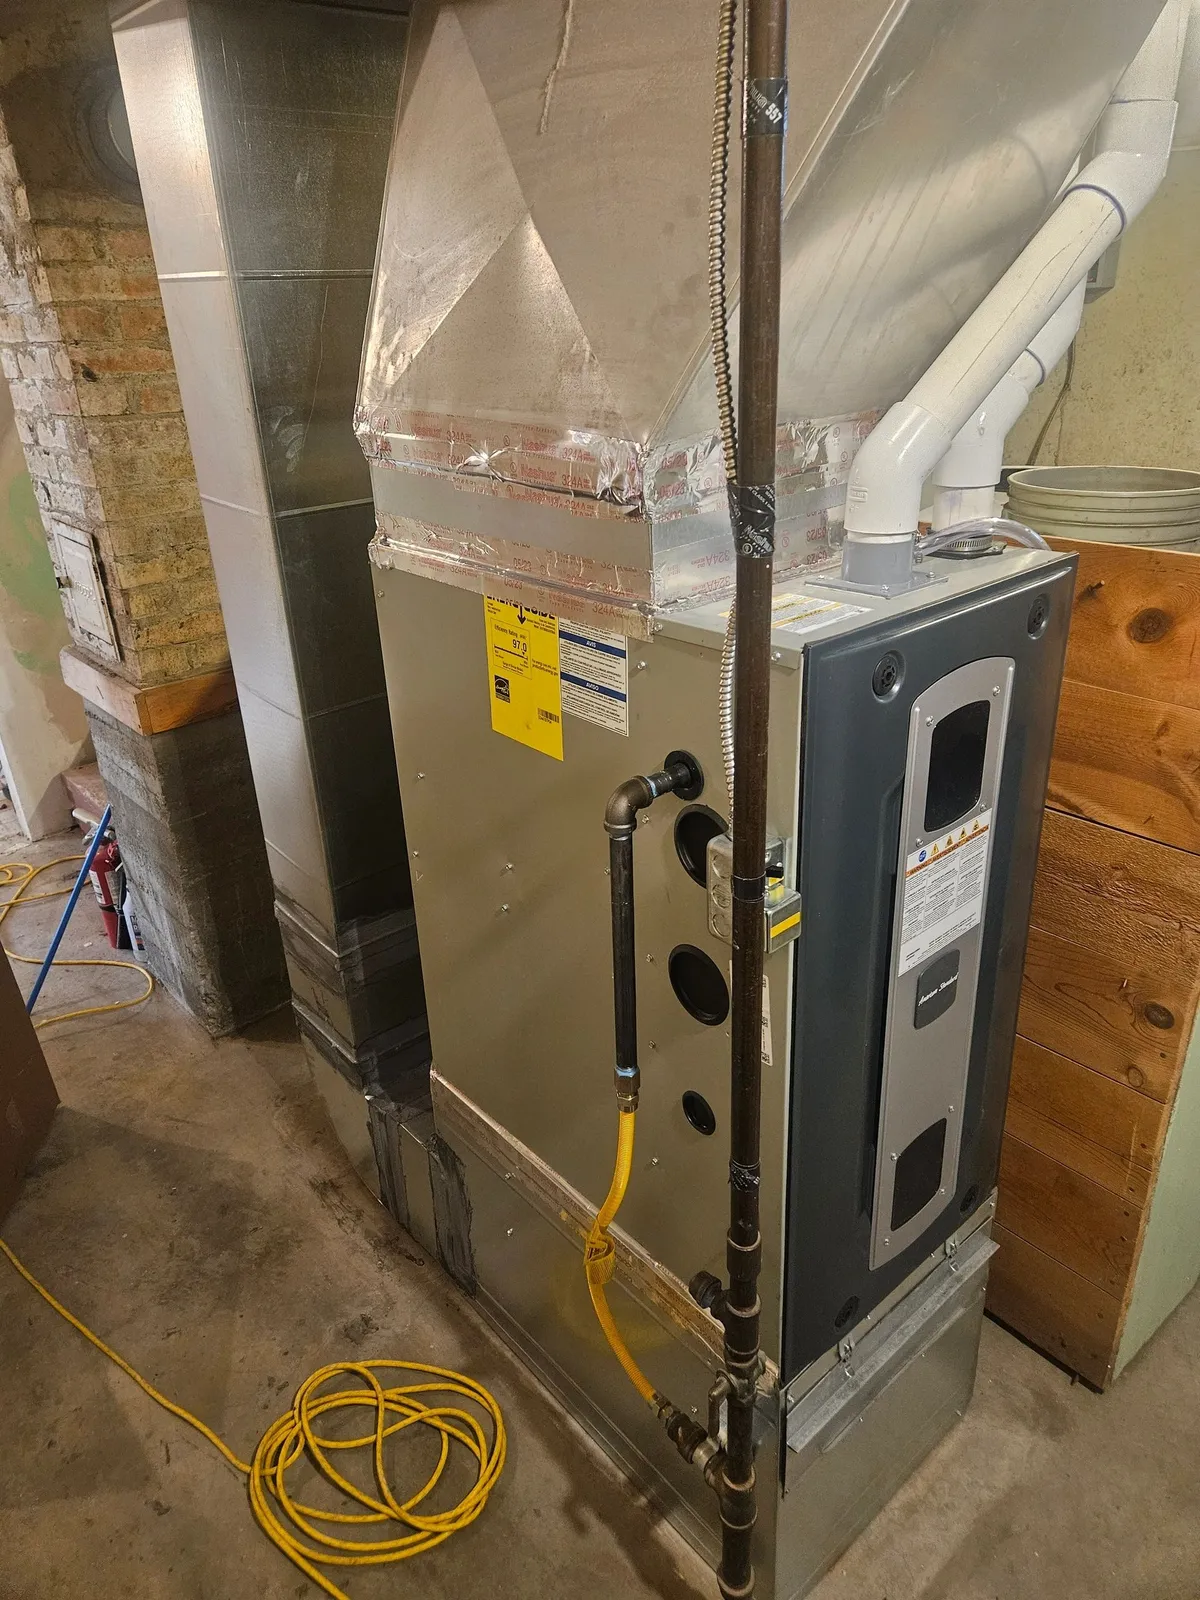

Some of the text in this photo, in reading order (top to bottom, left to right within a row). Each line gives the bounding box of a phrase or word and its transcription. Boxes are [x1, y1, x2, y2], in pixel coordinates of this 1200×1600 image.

[765, 102, 783, 124] 557
[562, 447, 583, 461] 324A
[521, 464, 583, 488] Nashua 324A
[706, 550, 730, 566] 324A
[591, 601, 615, 617] 324A
[512, 639, 528, 652] 97.0
[918, 972, 959, 1007] American Standard
